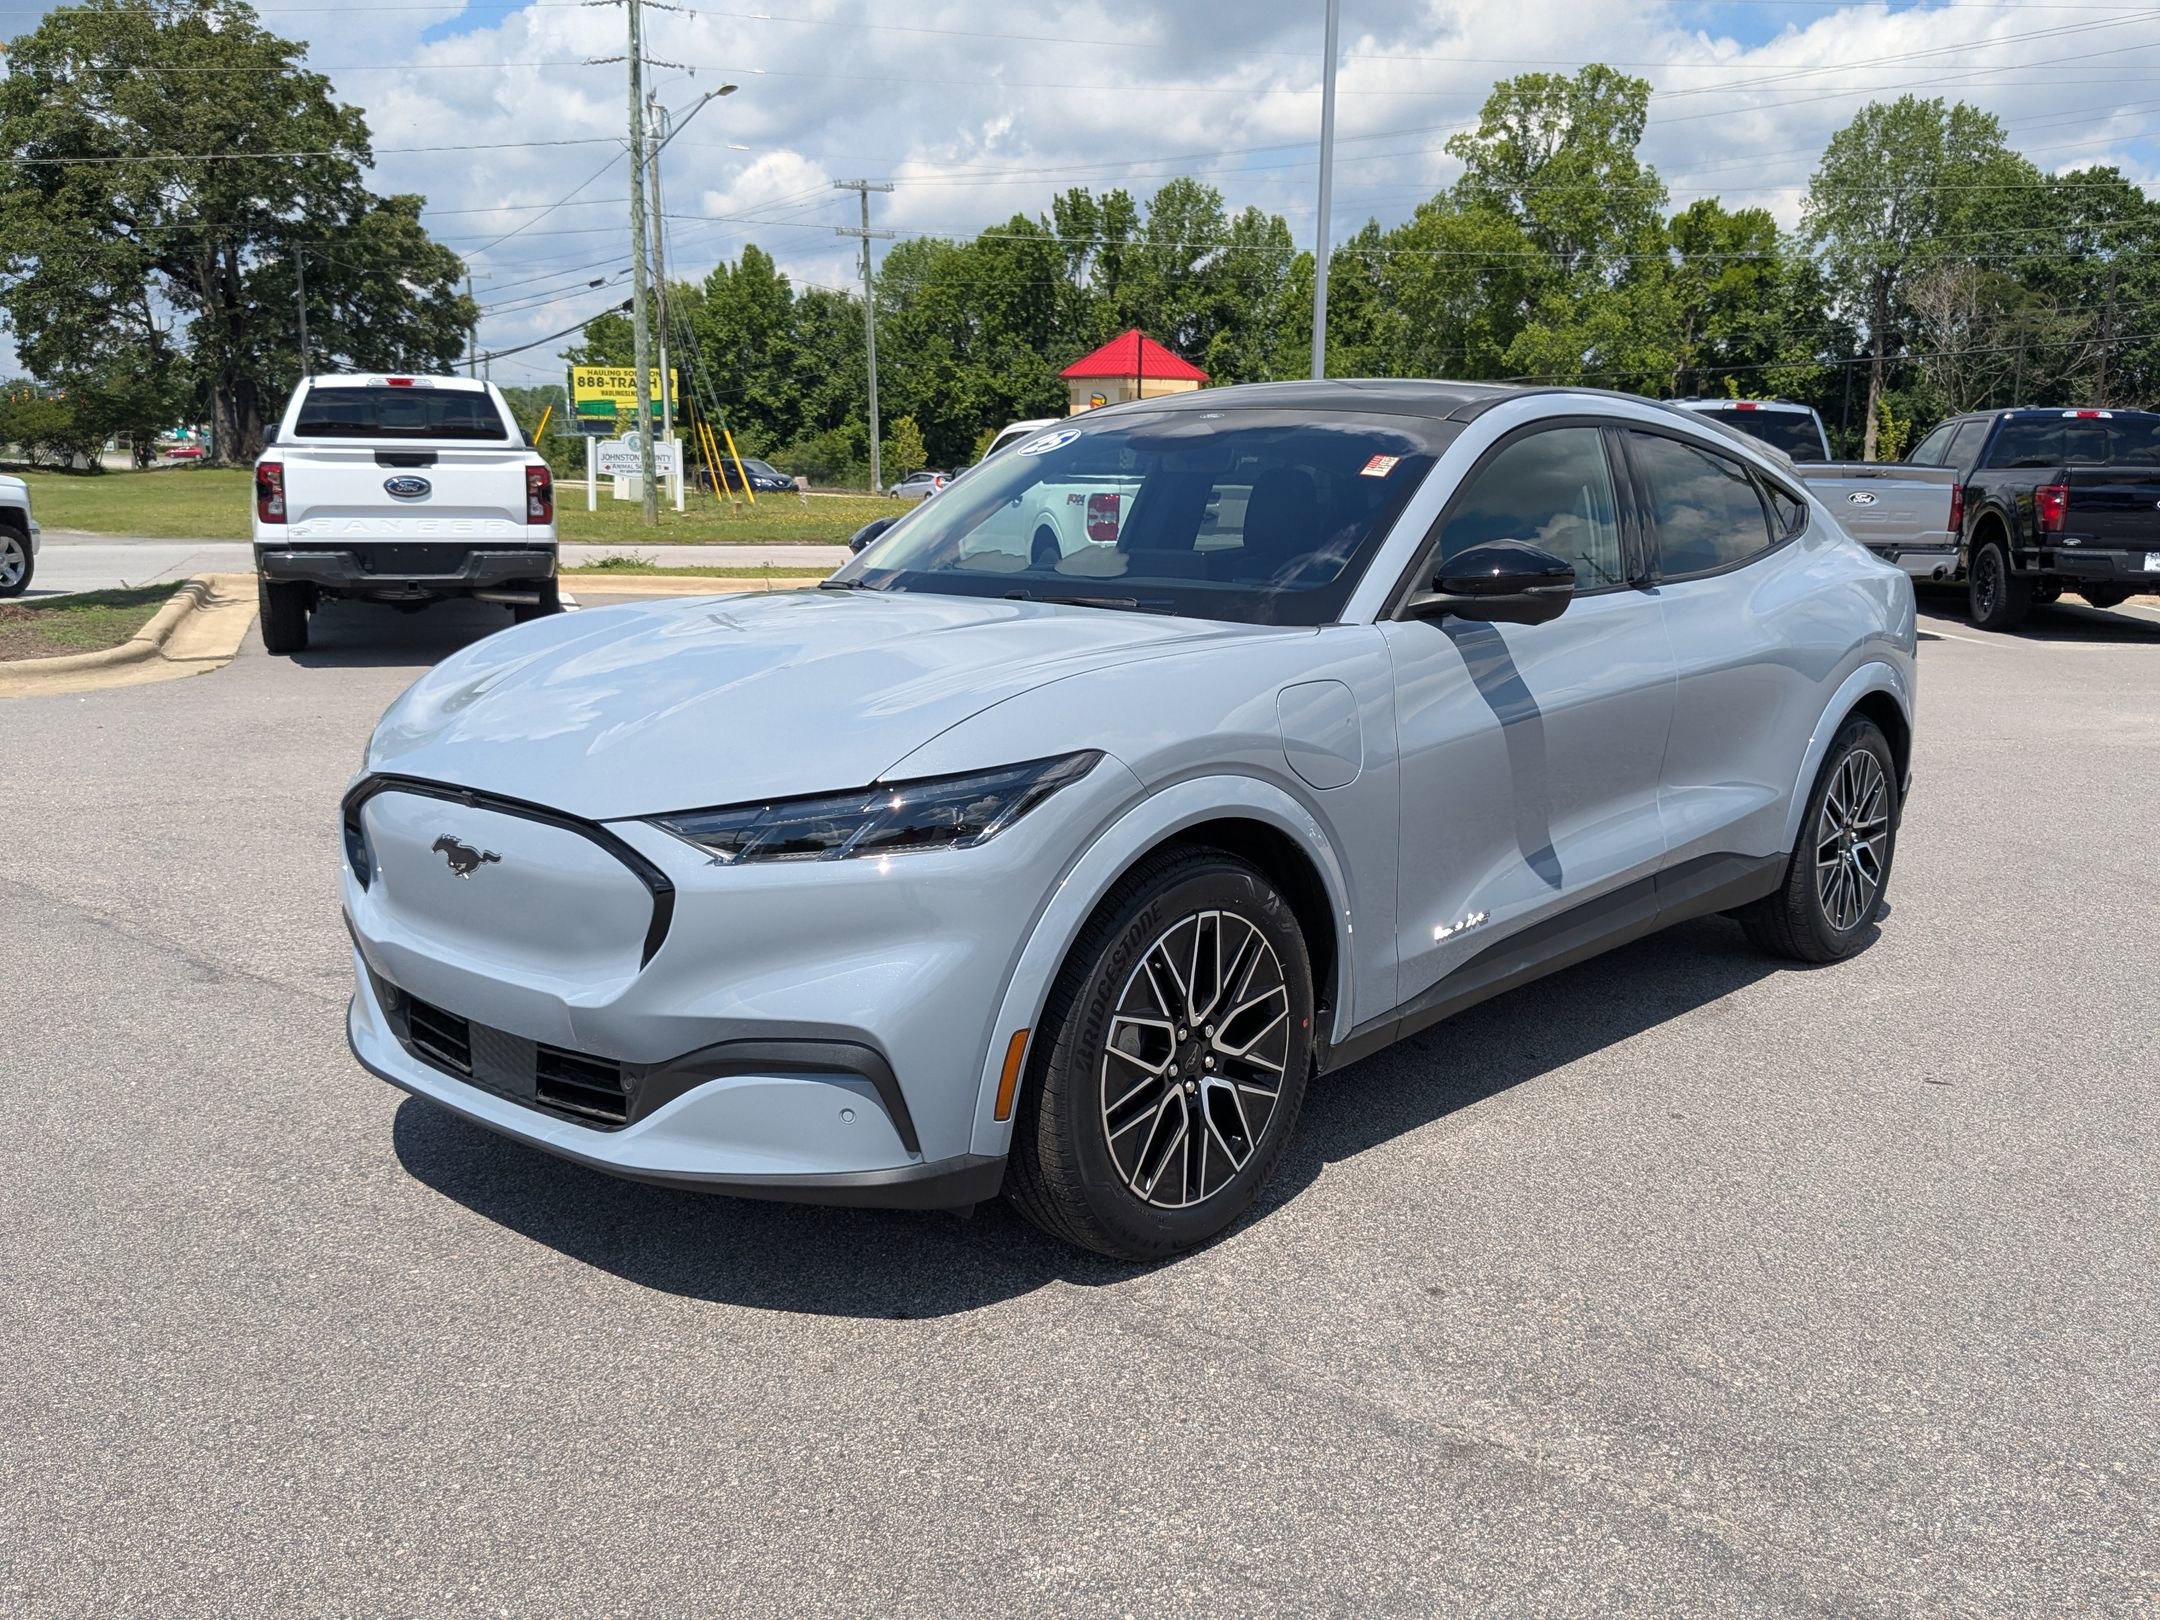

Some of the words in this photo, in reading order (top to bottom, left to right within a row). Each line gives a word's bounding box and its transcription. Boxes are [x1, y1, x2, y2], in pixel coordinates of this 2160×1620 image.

[587, 369, 621, 377] HAULING
[600, 453, 640, 461] JOHNSTON
[1076, 900, 1164, 1074] BRIDGESTONE
